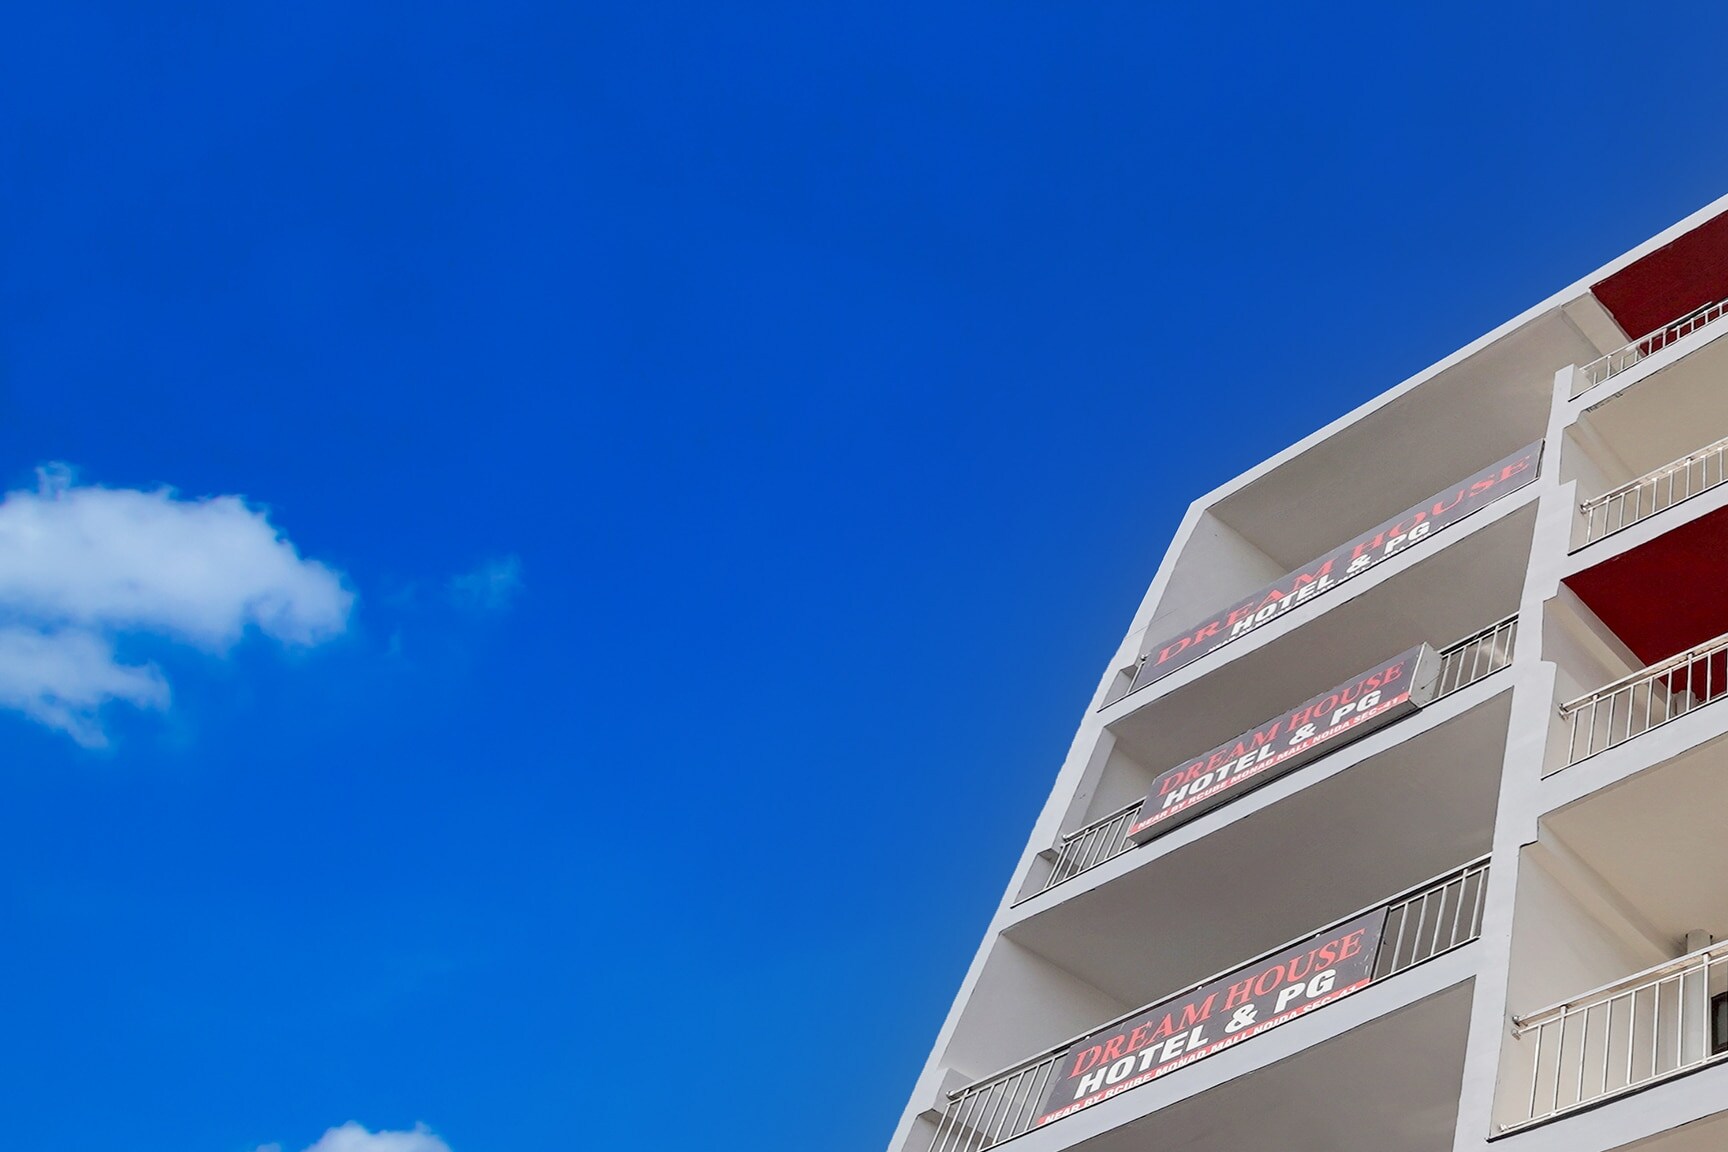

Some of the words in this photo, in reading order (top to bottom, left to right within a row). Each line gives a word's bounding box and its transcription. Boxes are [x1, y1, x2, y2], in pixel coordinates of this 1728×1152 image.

[1153, 557, 1339, 667] DREAM
[1352, 455, 1531, 558] HOUSE
[1230, 573, 1335, 636] HOTEL
[1346, 554, 1371, 574] &
[1384, 521, 1430, 554] PG
[1137, 807, 1170, 829] NEAR
[1169, 799, 1188, 814] BY
[1187, 782, 1228, 805] RCUBE
[1230, 760, 1274, 783] MONAD
[1277, 741, 1309, 760] MALL
[1312, 723, 1350, 743] NOIDA
[1353, 697, 1398, 724] SEC-41
[1157, 720, 1283, 797] DREAM
[1285, 661, 1405, 733] HOUSE
[1162, 743, 1275, 809] HOTEL
[1289, 722, 1317, 746] &
[1329, 690, 1382, 726] PG
[1067, 991, 1219, 1080] DREAM
[1220, 928, 1366, 1013] HOUSE
[1073, 1025, 1209, 1100] HOTEL
[1224, 1003, 1259, 1033] &
[1273, 969, 1337, 1014] PG
